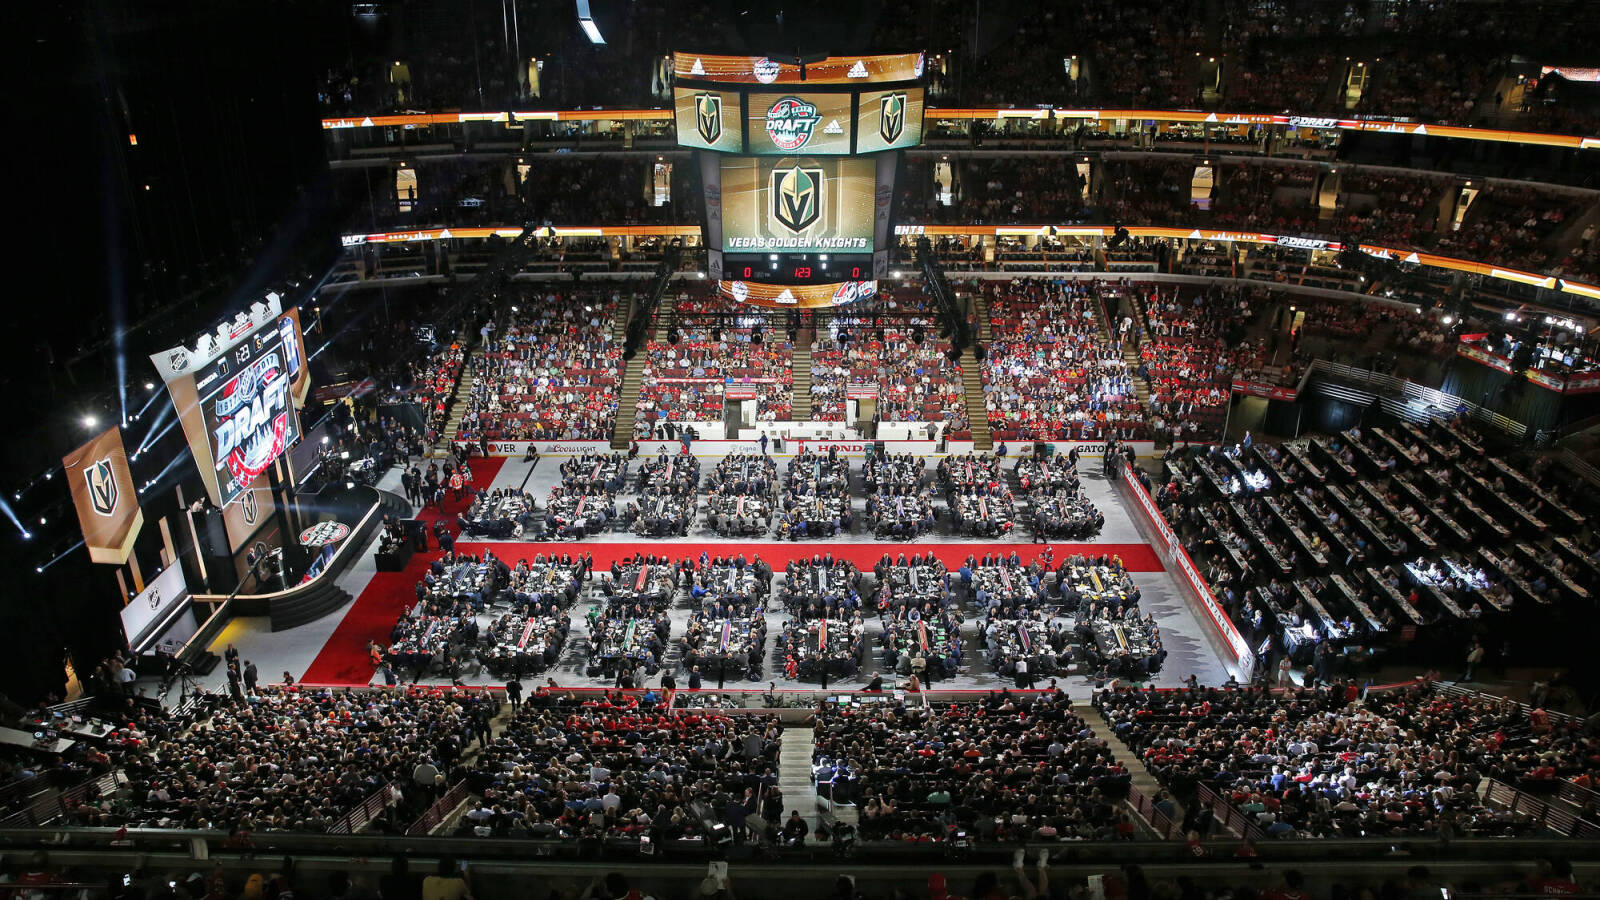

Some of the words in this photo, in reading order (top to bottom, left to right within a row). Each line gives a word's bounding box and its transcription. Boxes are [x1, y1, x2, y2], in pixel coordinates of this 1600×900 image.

[766, 118, 817, 131] DRAFT
[1300, 116, 1337, 127] DRAFT
[728, 237, 766, 248] VEGAS
[768, 237, 812, 248] GOLDEN
[815, 237, 867, 248] KNIGHTS
[1288, 237, 1327, 249] DRAFT
[744, 267, 752, 278] 0
[852, 267, 860, 278] 0
[255, 354, 275, 374] 2017
[214, 372, 289, 463] DRAFT
[553, 444, 576, 453] Coors
